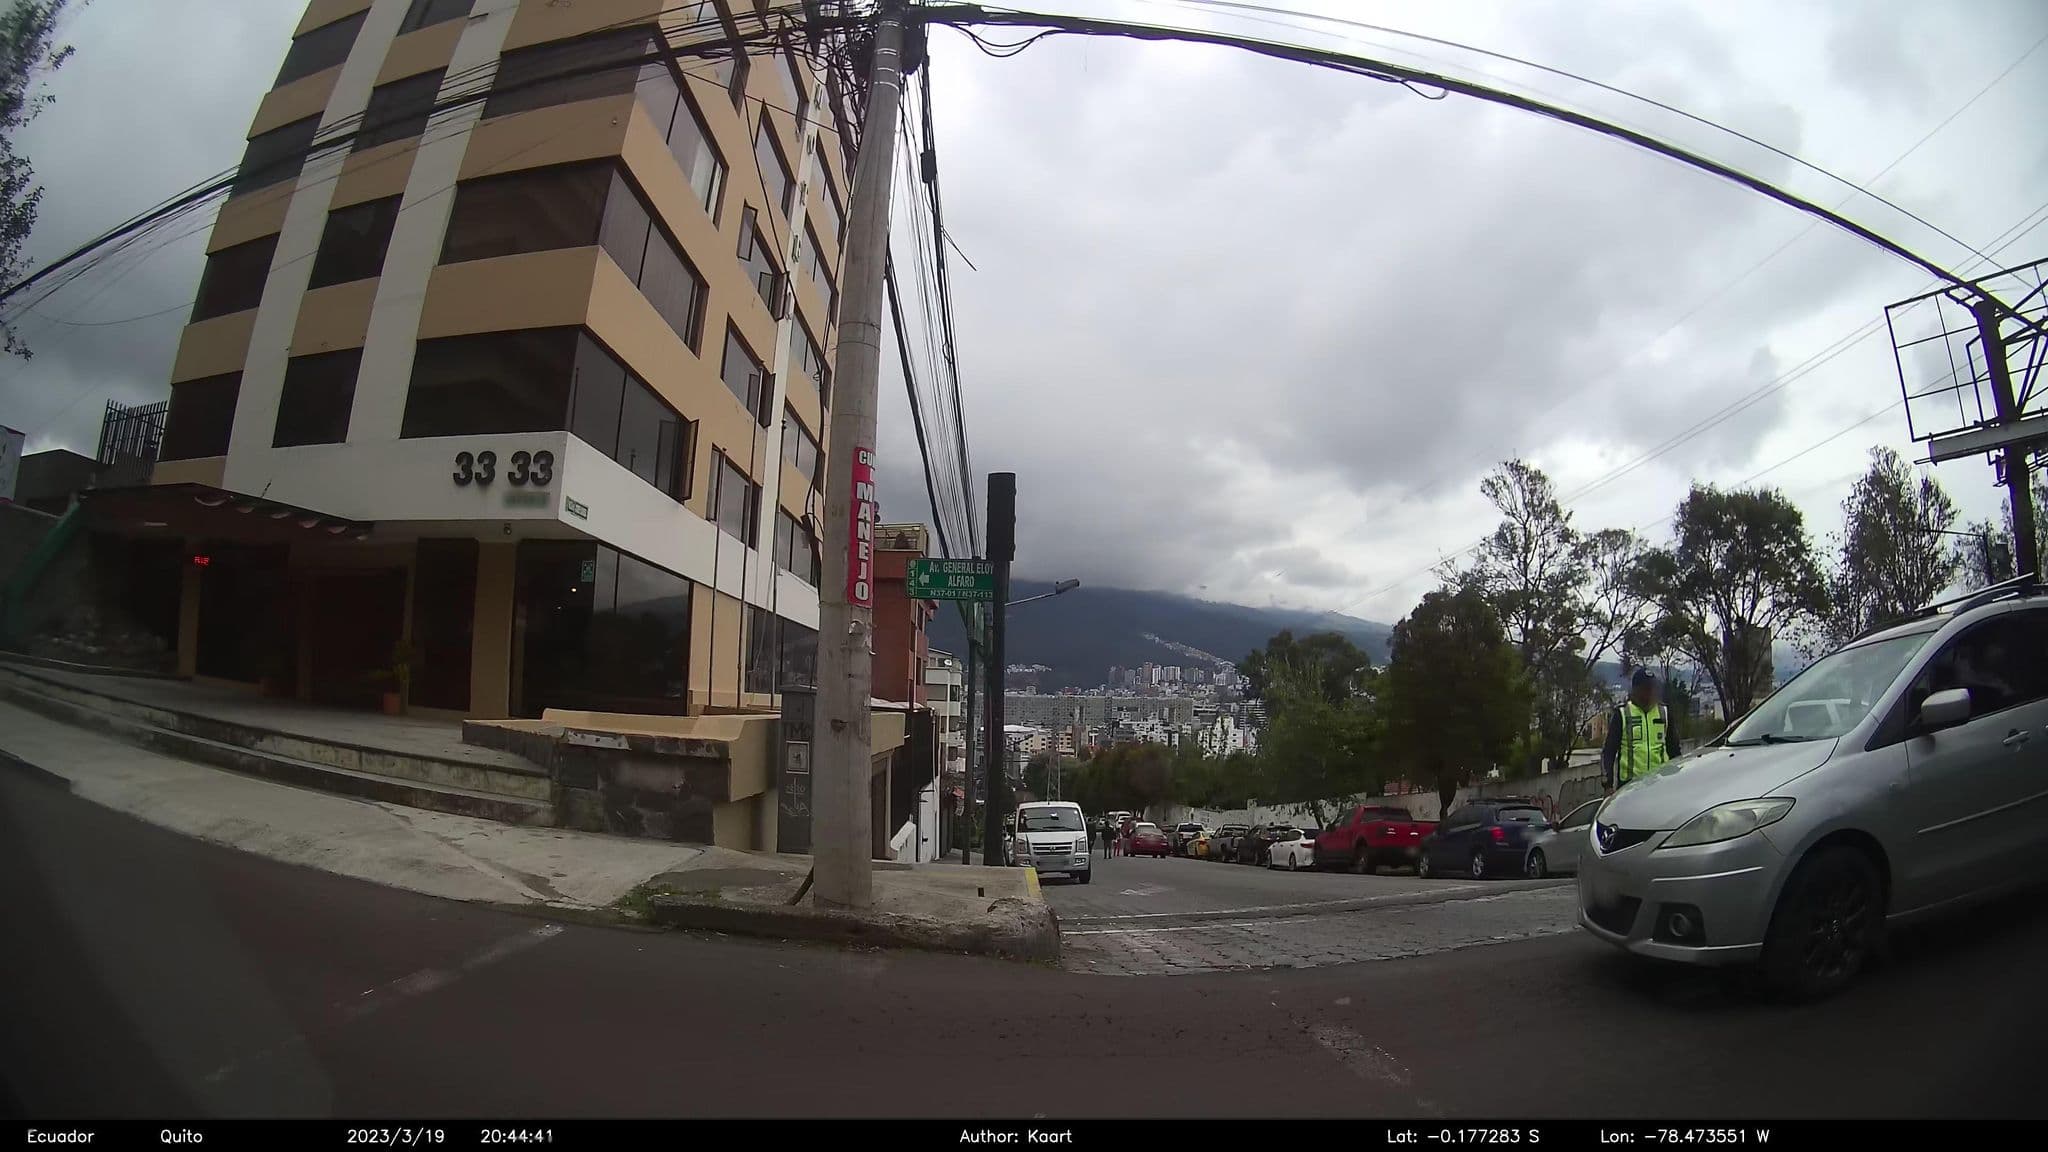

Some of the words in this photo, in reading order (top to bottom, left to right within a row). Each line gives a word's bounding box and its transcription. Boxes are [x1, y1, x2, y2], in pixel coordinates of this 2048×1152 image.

[453, 451, 497, 486] 33
[508, 450, 554, 486] 33
[855, 482, 872, 600] MANEJO
[943, 562, 975, 574] GENERAL
[947, 575, 975, 588] ALFARO
